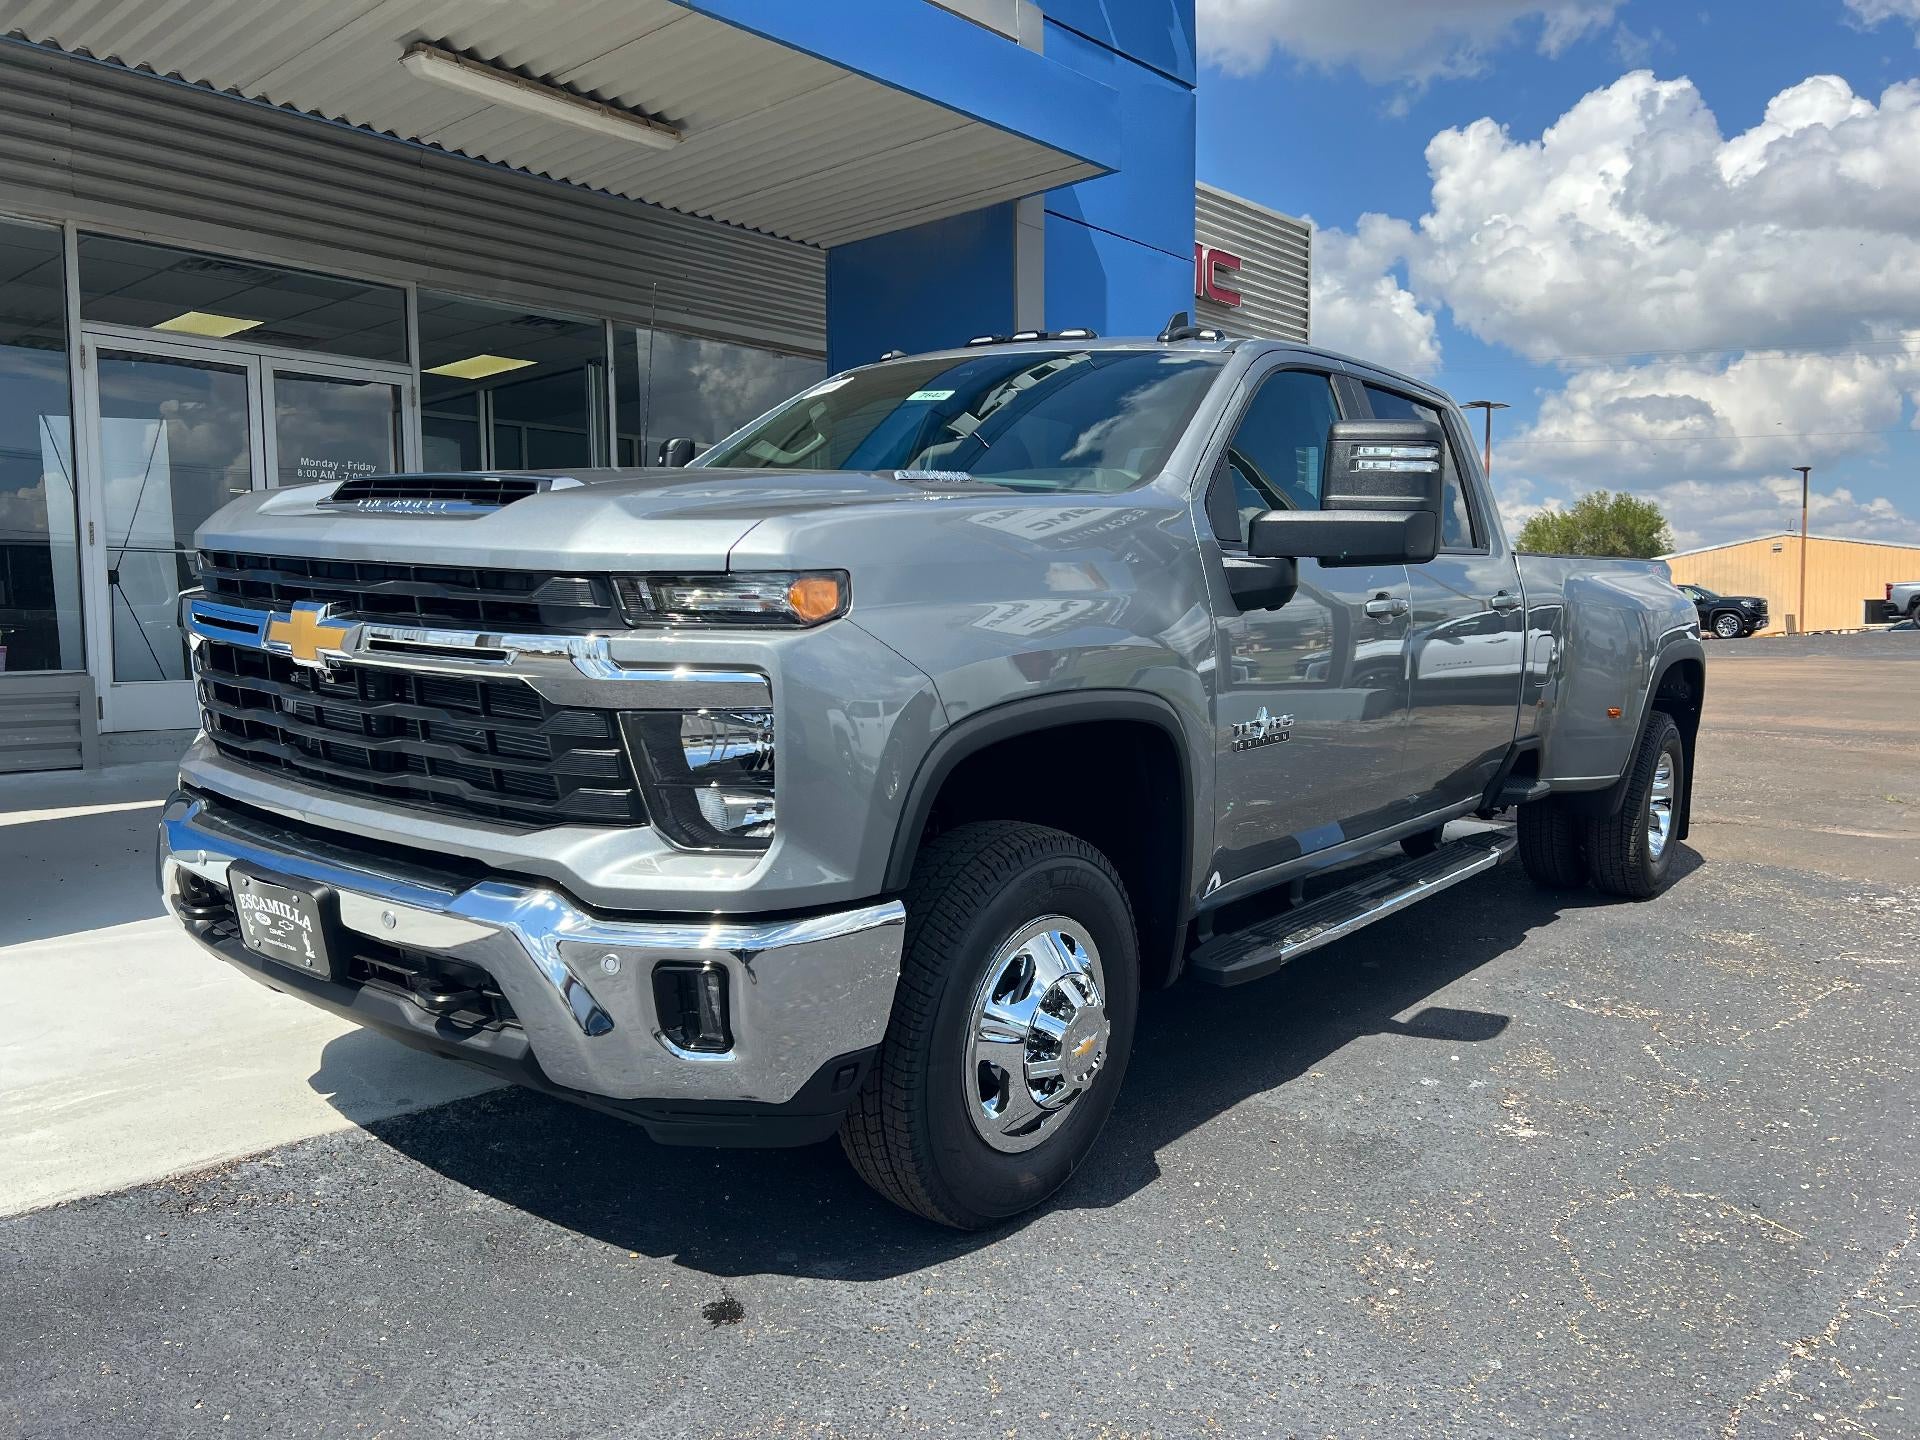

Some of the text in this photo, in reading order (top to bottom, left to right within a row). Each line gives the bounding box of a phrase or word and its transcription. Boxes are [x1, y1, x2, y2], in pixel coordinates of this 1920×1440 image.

[300, 457, 339, 471] Monday
[347, 460, 377, 473] Friday
[297, 468, 318, 478] 8:00
[319, 470, 336, 479] AM
[1239, 732, 1288, 749] EDITION
[239, 893, 313, 932] ESCAMILLA
